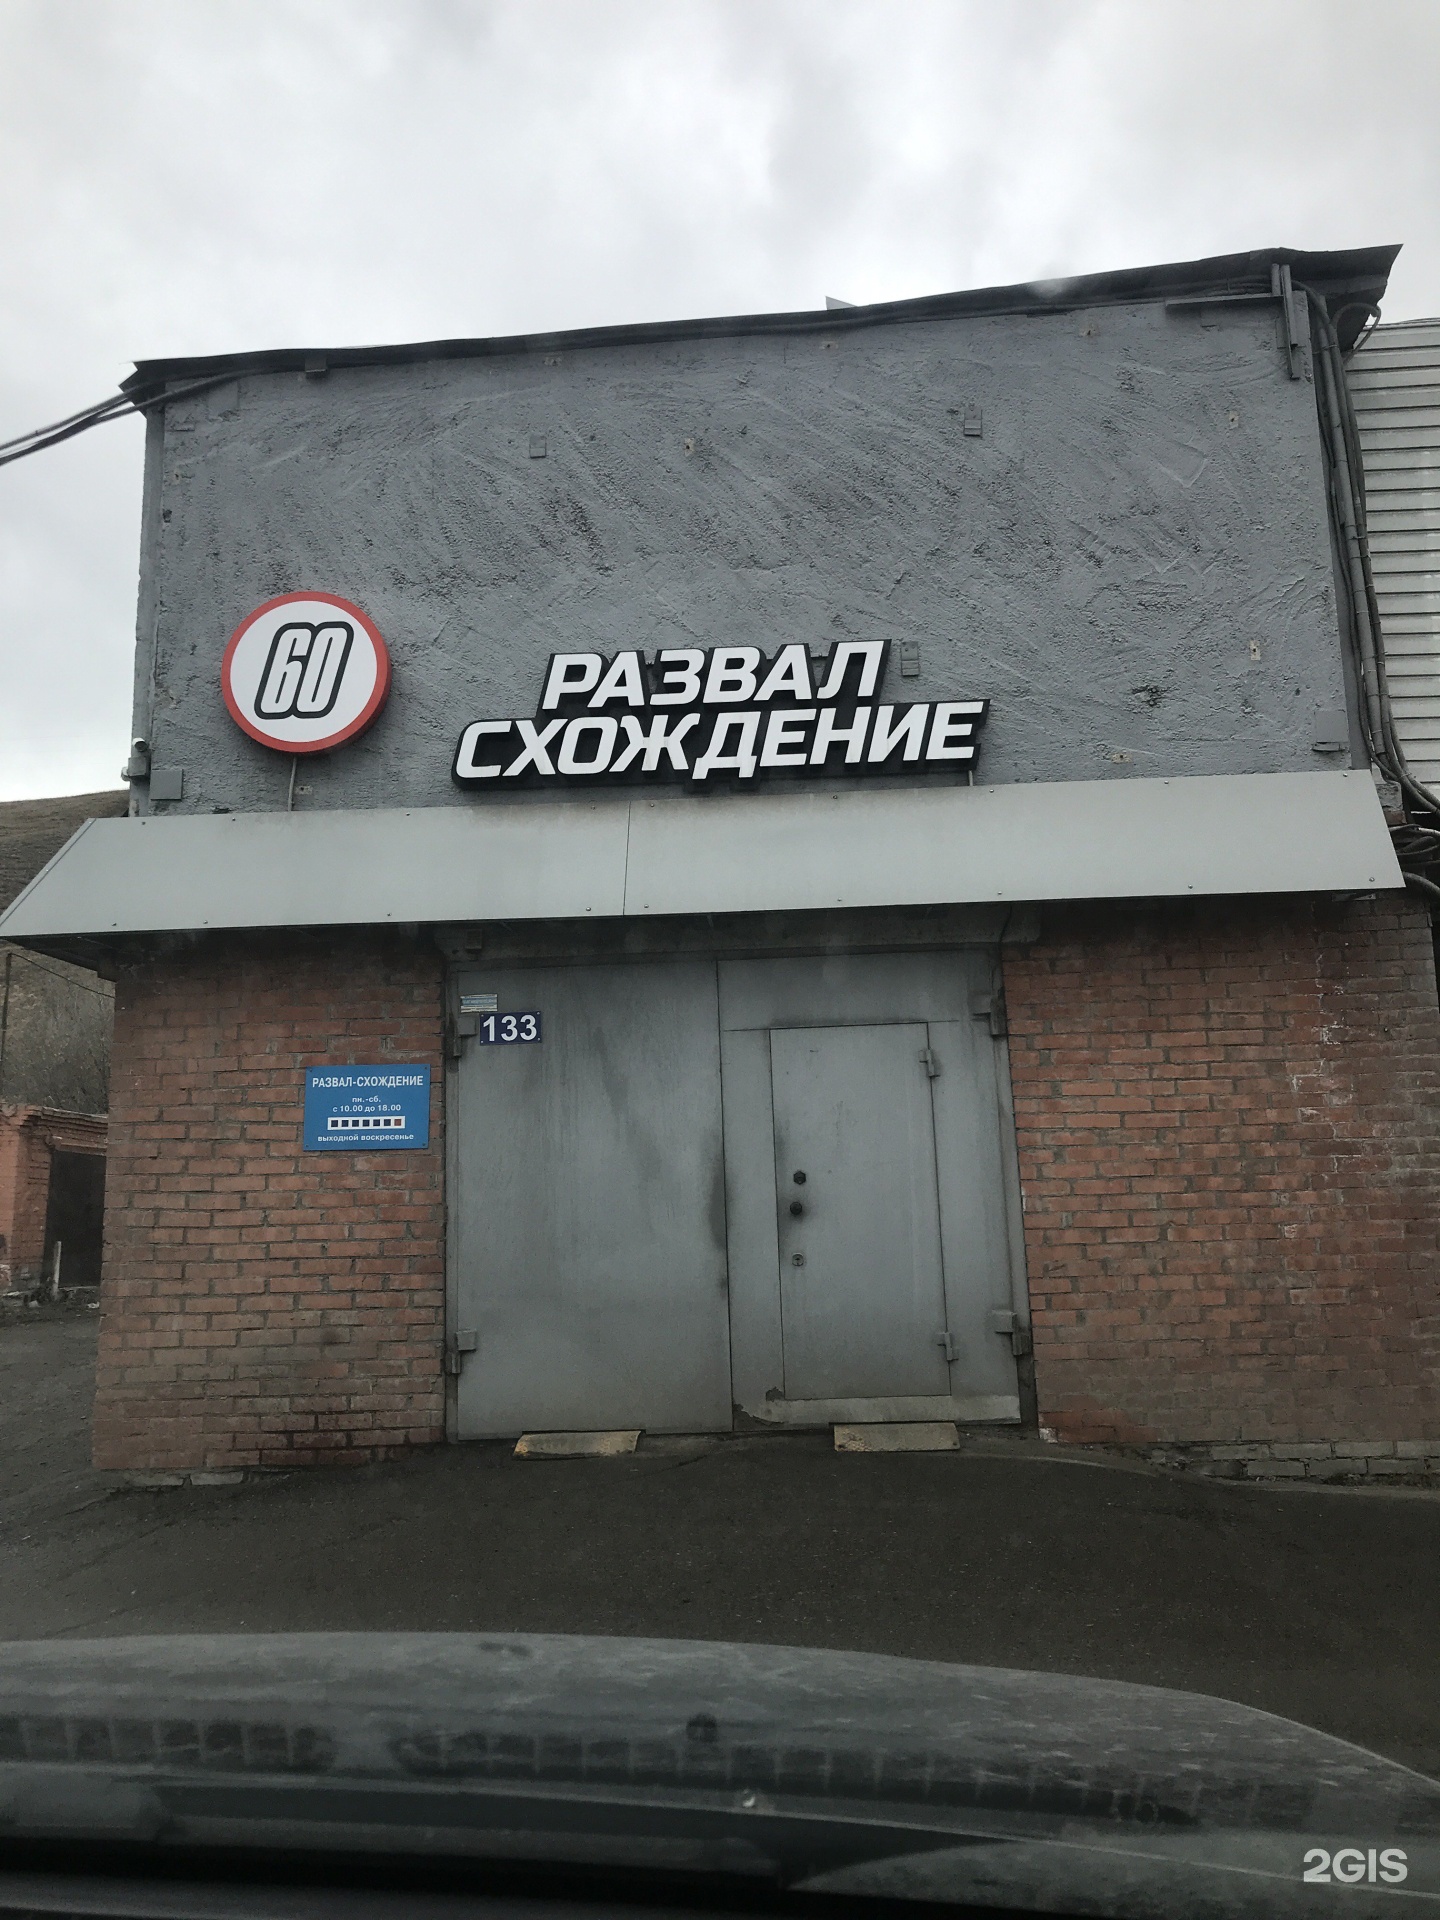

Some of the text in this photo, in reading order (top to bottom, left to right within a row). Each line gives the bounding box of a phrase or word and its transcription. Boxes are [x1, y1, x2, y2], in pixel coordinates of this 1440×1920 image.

[254, 621, 354, 720] 60
[541, 640, 885, 711] РАЗВАЛ
[455, 700, 984, 780] СХОЖДЕНИЕ
[483, 1014, 537, 1042] 133
[312, 1075, 424, 1088] РАЗВАЛ-СХОЖДЕНИЕ
[352, 1095, 381, 1103] пн.-сб.
[378, 1104, 402, 1112] 18.00
[317, 1134, 414, 1143] выходной воскресенье
